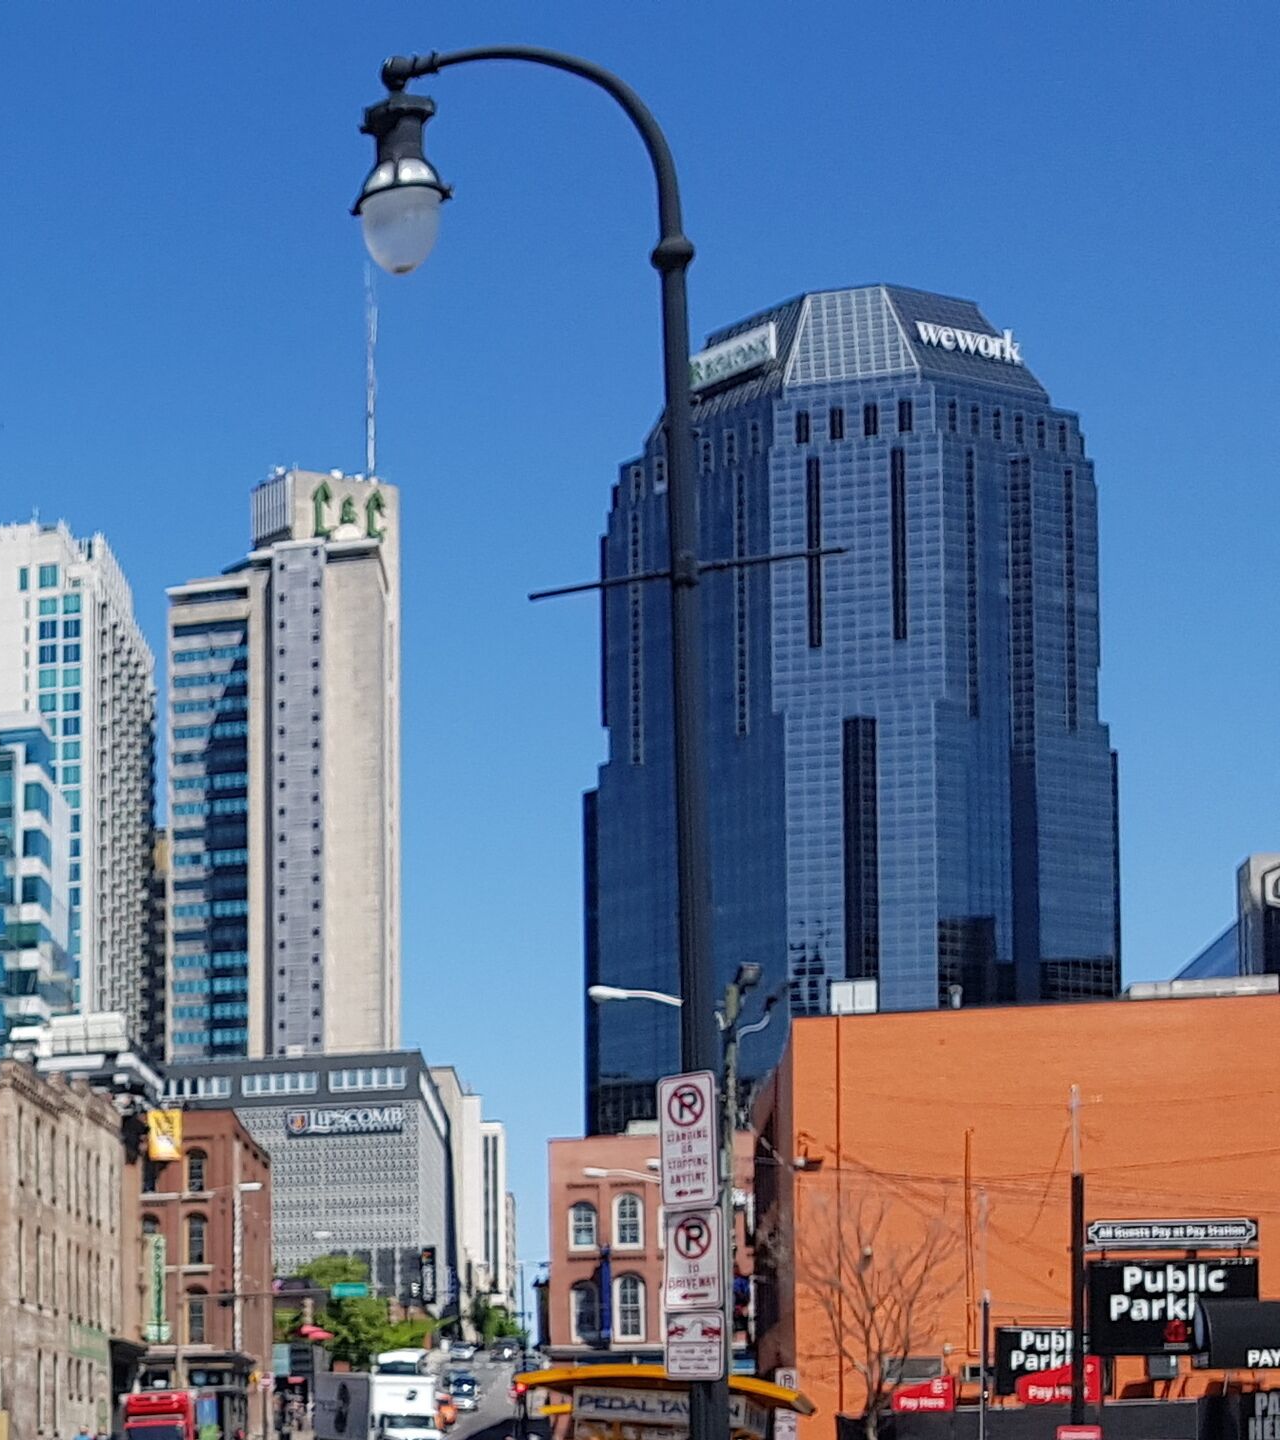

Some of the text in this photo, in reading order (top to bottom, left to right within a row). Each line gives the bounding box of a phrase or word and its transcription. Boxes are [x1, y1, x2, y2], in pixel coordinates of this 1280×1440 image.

[915, 321, 1025, 366] wework
[308, 1106, 402, 1134] LIPSCOMB
[1123, 1263, 1226, 1293] Public
[1109, 1292, 1196, 1321] Parki
[1020, 1329, 1088, 1351] Publ
